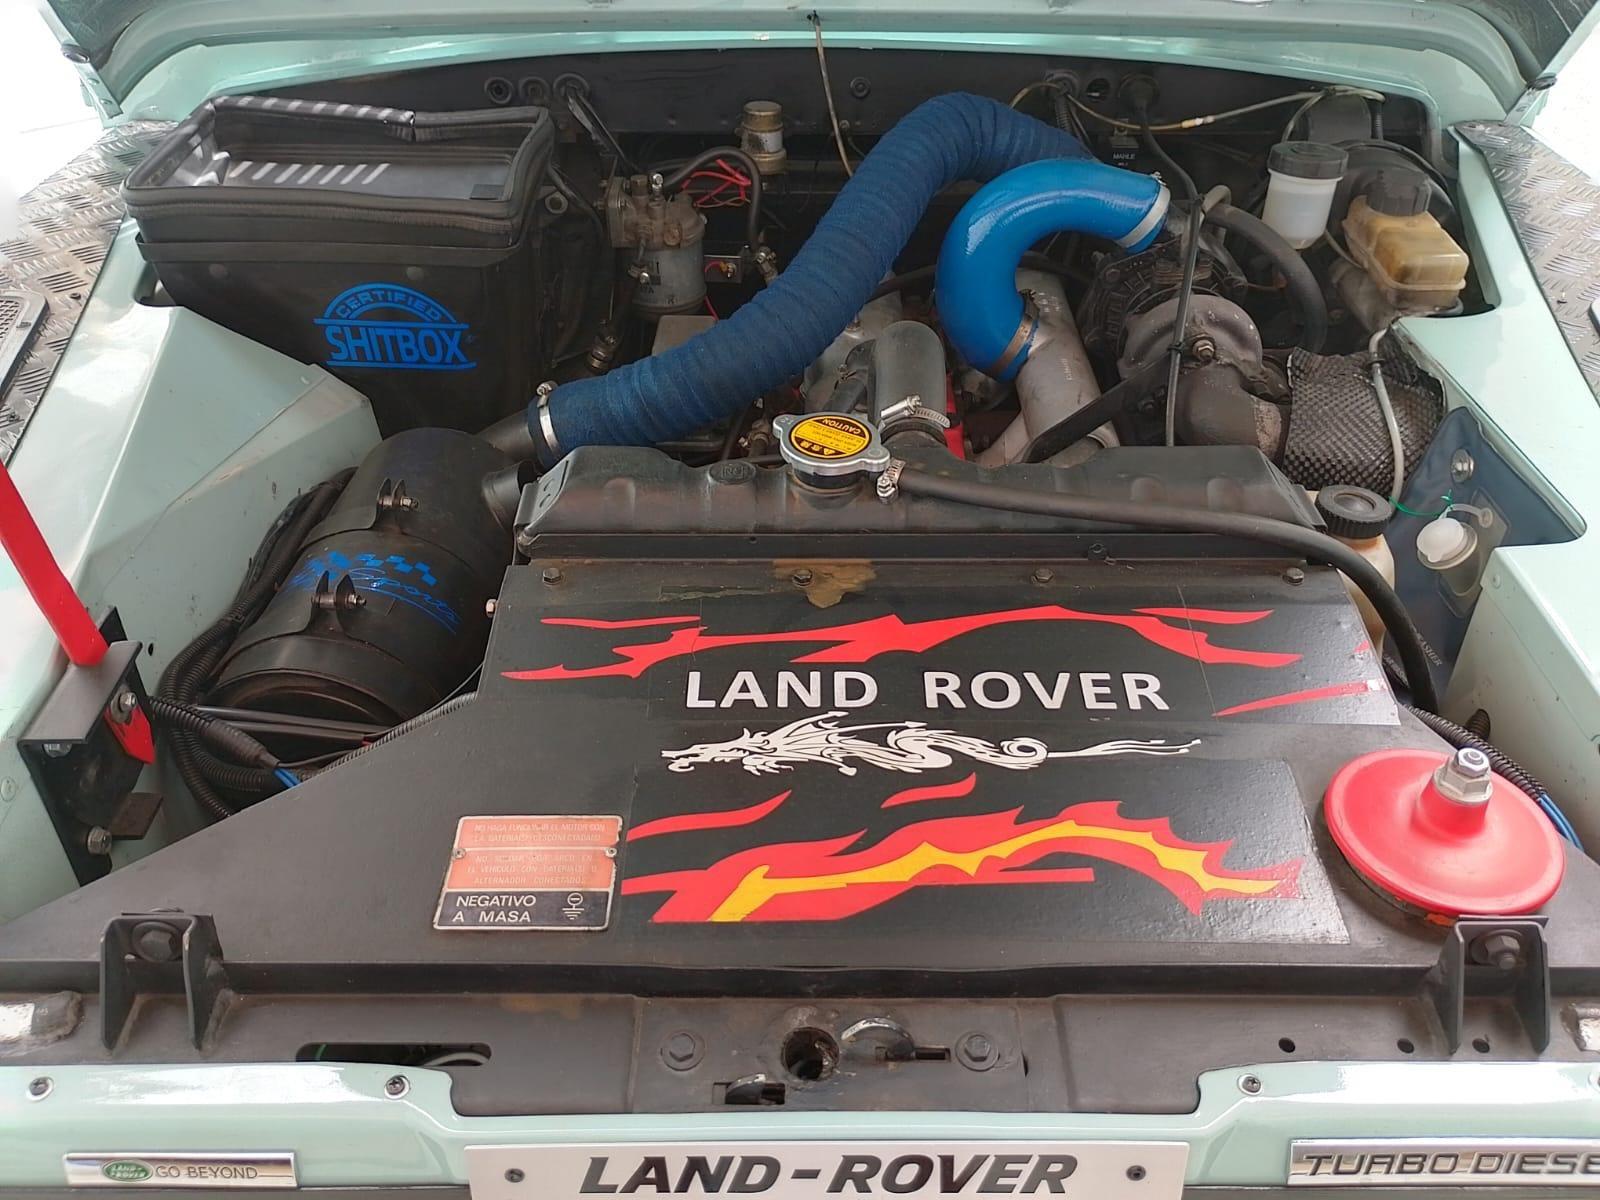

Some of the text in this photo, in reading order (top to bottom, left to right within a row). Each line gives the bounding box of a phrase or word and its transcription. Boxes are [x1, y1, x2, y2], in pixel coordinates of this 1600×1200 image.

[335, 289, 442, 321] CERTIFIED
[325, 325, 469, 363] SHITBOX
[823, 418, 861, 434] CAUTION
[686, 670, 1170, 711] LAND ROVER
[456, 895, 537, 907] NEGATIVO
[452, 910, 531, 922] A MASA
[155, 1165, 258, 1179] GO BEYOND
[579, 1154, 1079, 1195] LAND-ROVER
[1302, 1151, 1460, 1177] TURBO
[110, 1171, 146, 1179] ROVER
